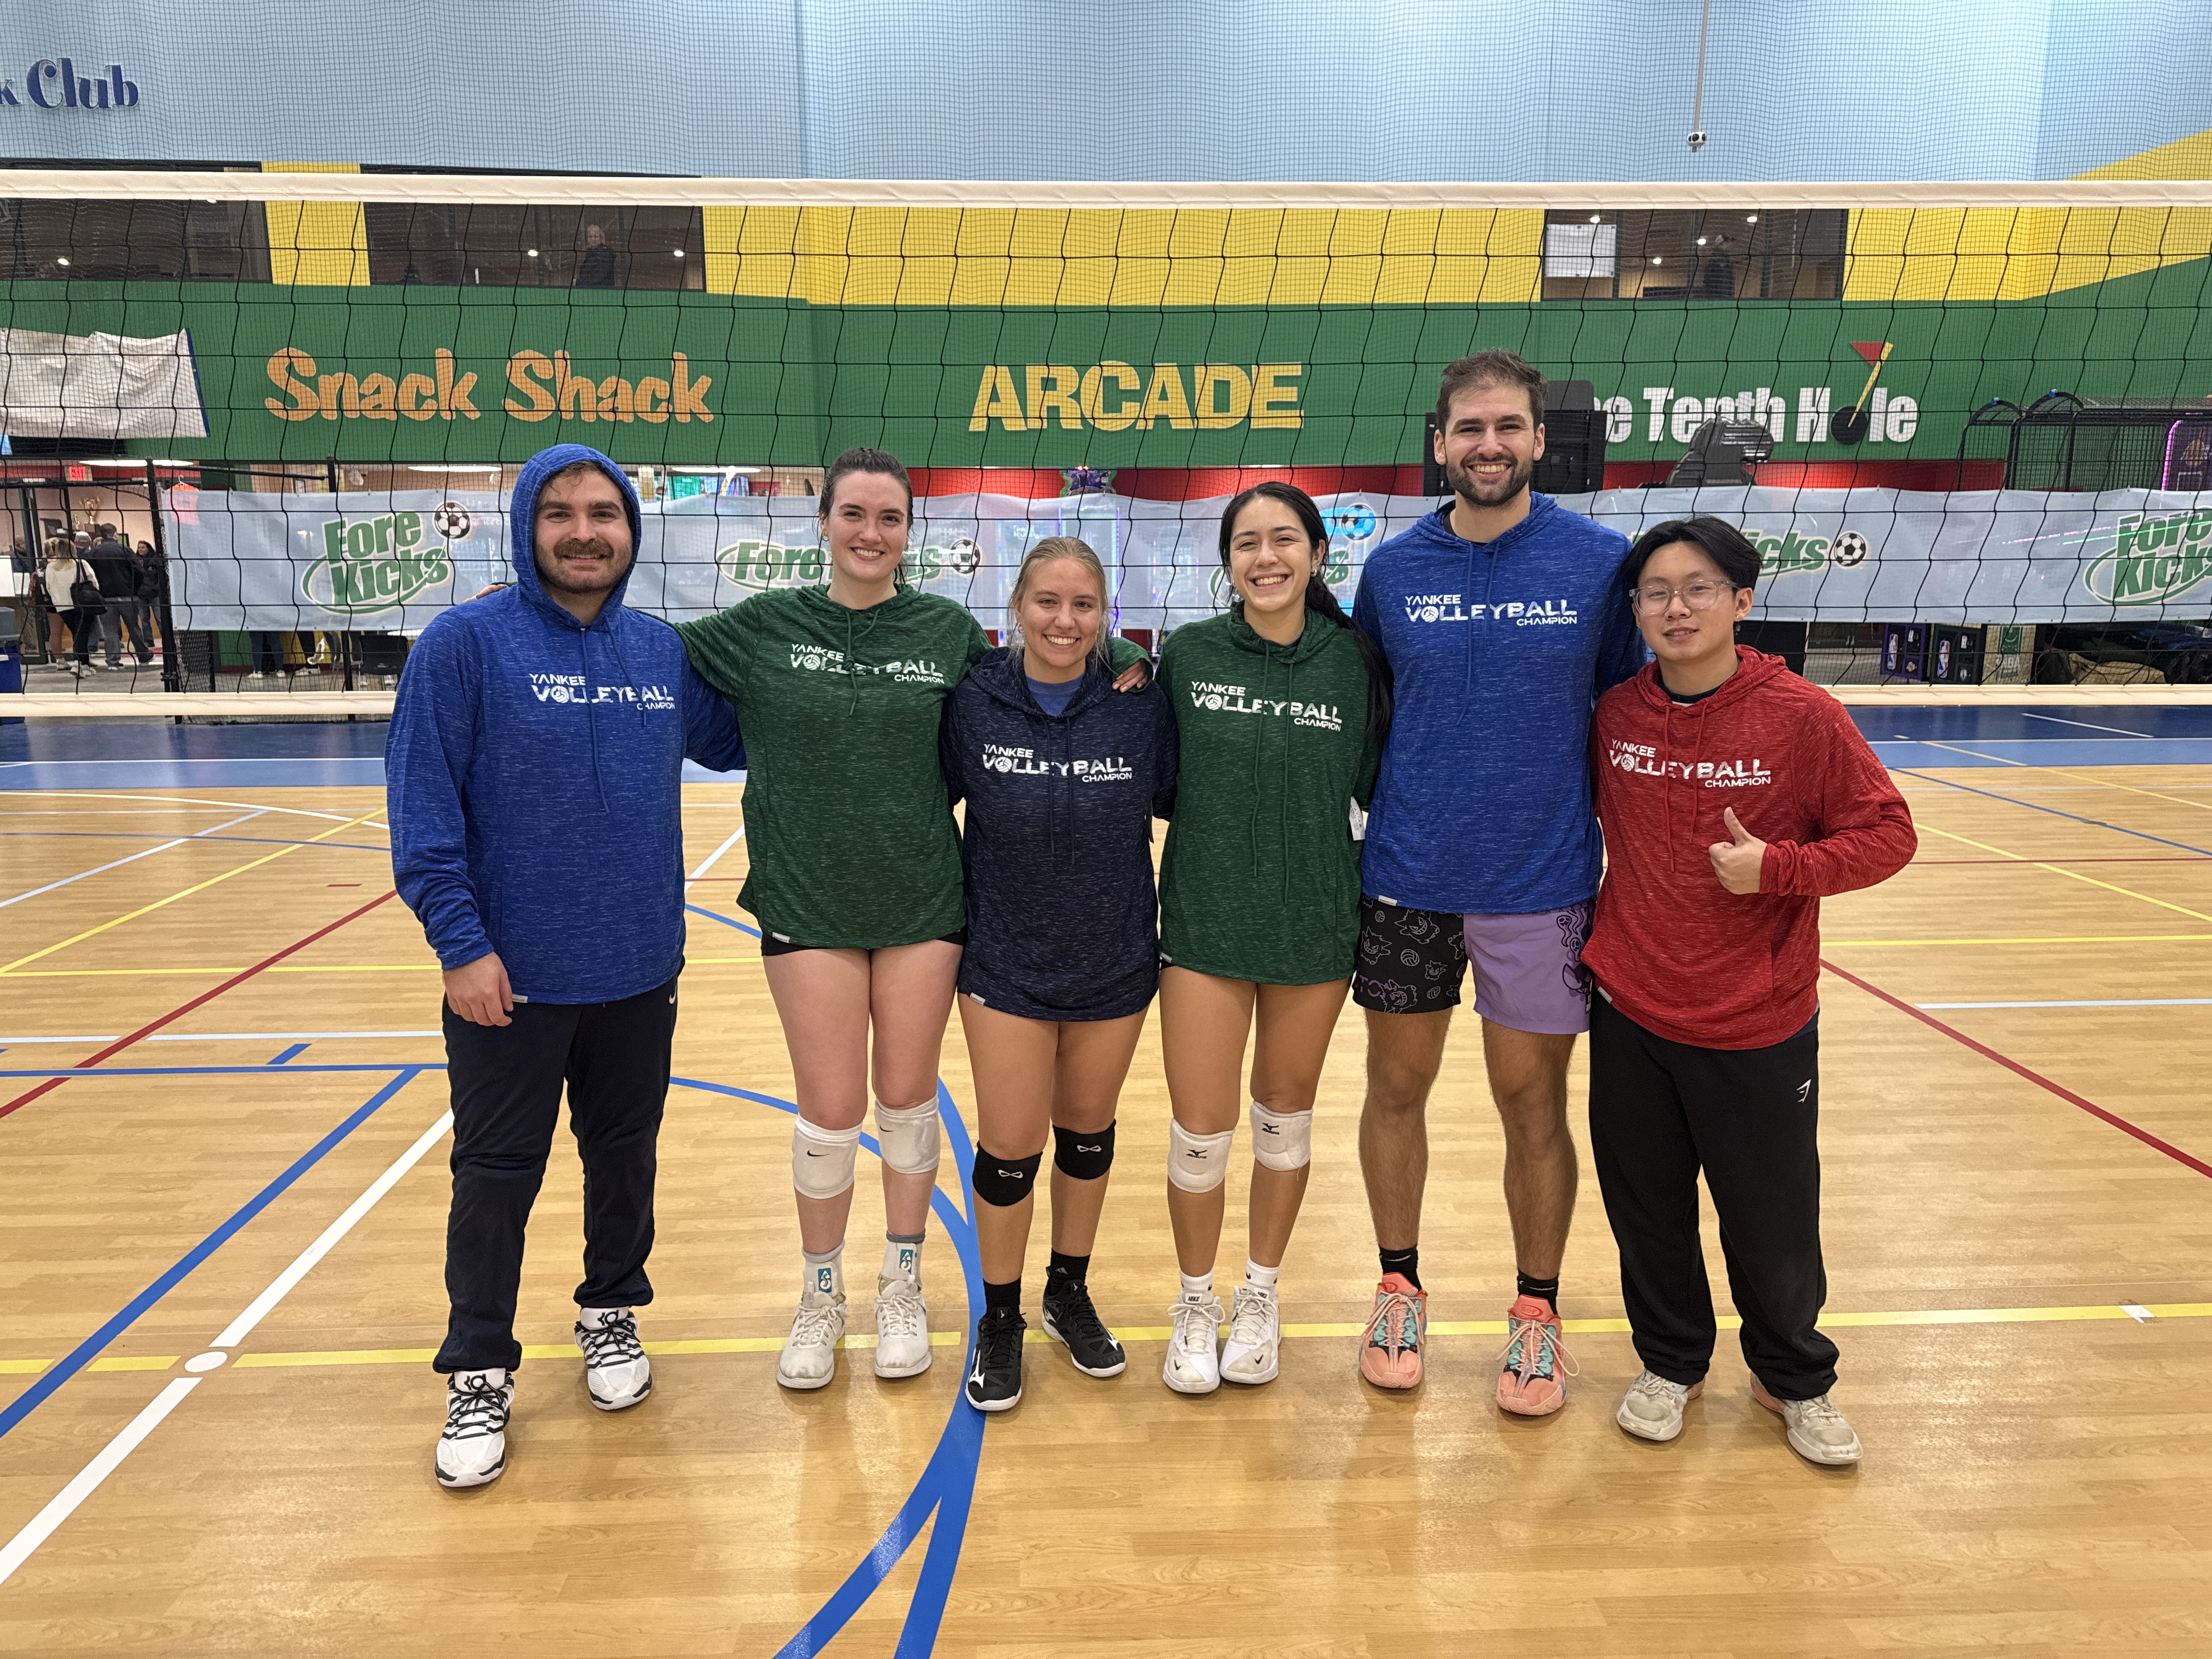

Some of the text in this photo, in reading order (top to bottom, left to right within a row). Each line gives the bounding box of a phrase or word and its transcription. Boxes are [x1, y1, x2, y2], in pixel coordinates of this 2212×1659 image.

[26, 57, 139, 109] Club
[264, 347, 714, 423] Snack Shack
[969, 360, 1304, 431] ARCADE
[324, 511, 421, 565] Fore
[734, 541, 824, 580] Fore
[1741, 532, 1829, 571] cks
[330, 549, 448, 607] Kicks
[2114, 543, 2212, 598] Kick
[1405, 594, 1462, 605] YANKEE
[1406, 599, 1577, 623] VOLLEYBALL
[1516, 616, 1577, 626] CHAMPION
[791, 644, 844, 662] YANKEE
[529, 673, 586, 686] YANKEE
[894, 674, 945, 684] CHAMPION
[1192, 681, 1246, 696] YANKEE
[531, 684, 675, 704] VOLLEYBALL
[1190, 691, 1342, 724] VOLLEYBALL
[1294, 717, 1341, 732] CHAMPION
[984, 743, 1034, 758] YANKEE
[1612, 738, 1656, 758] YANKEE
[982, 754, 1132, 776] VOLLEYBALL
[1609, 749, 1771, 780] VOLLEYBALL
[1081, 772, 1132, 783] CHAMPION
[1705, 776, 1771, 788] CHAMPION
